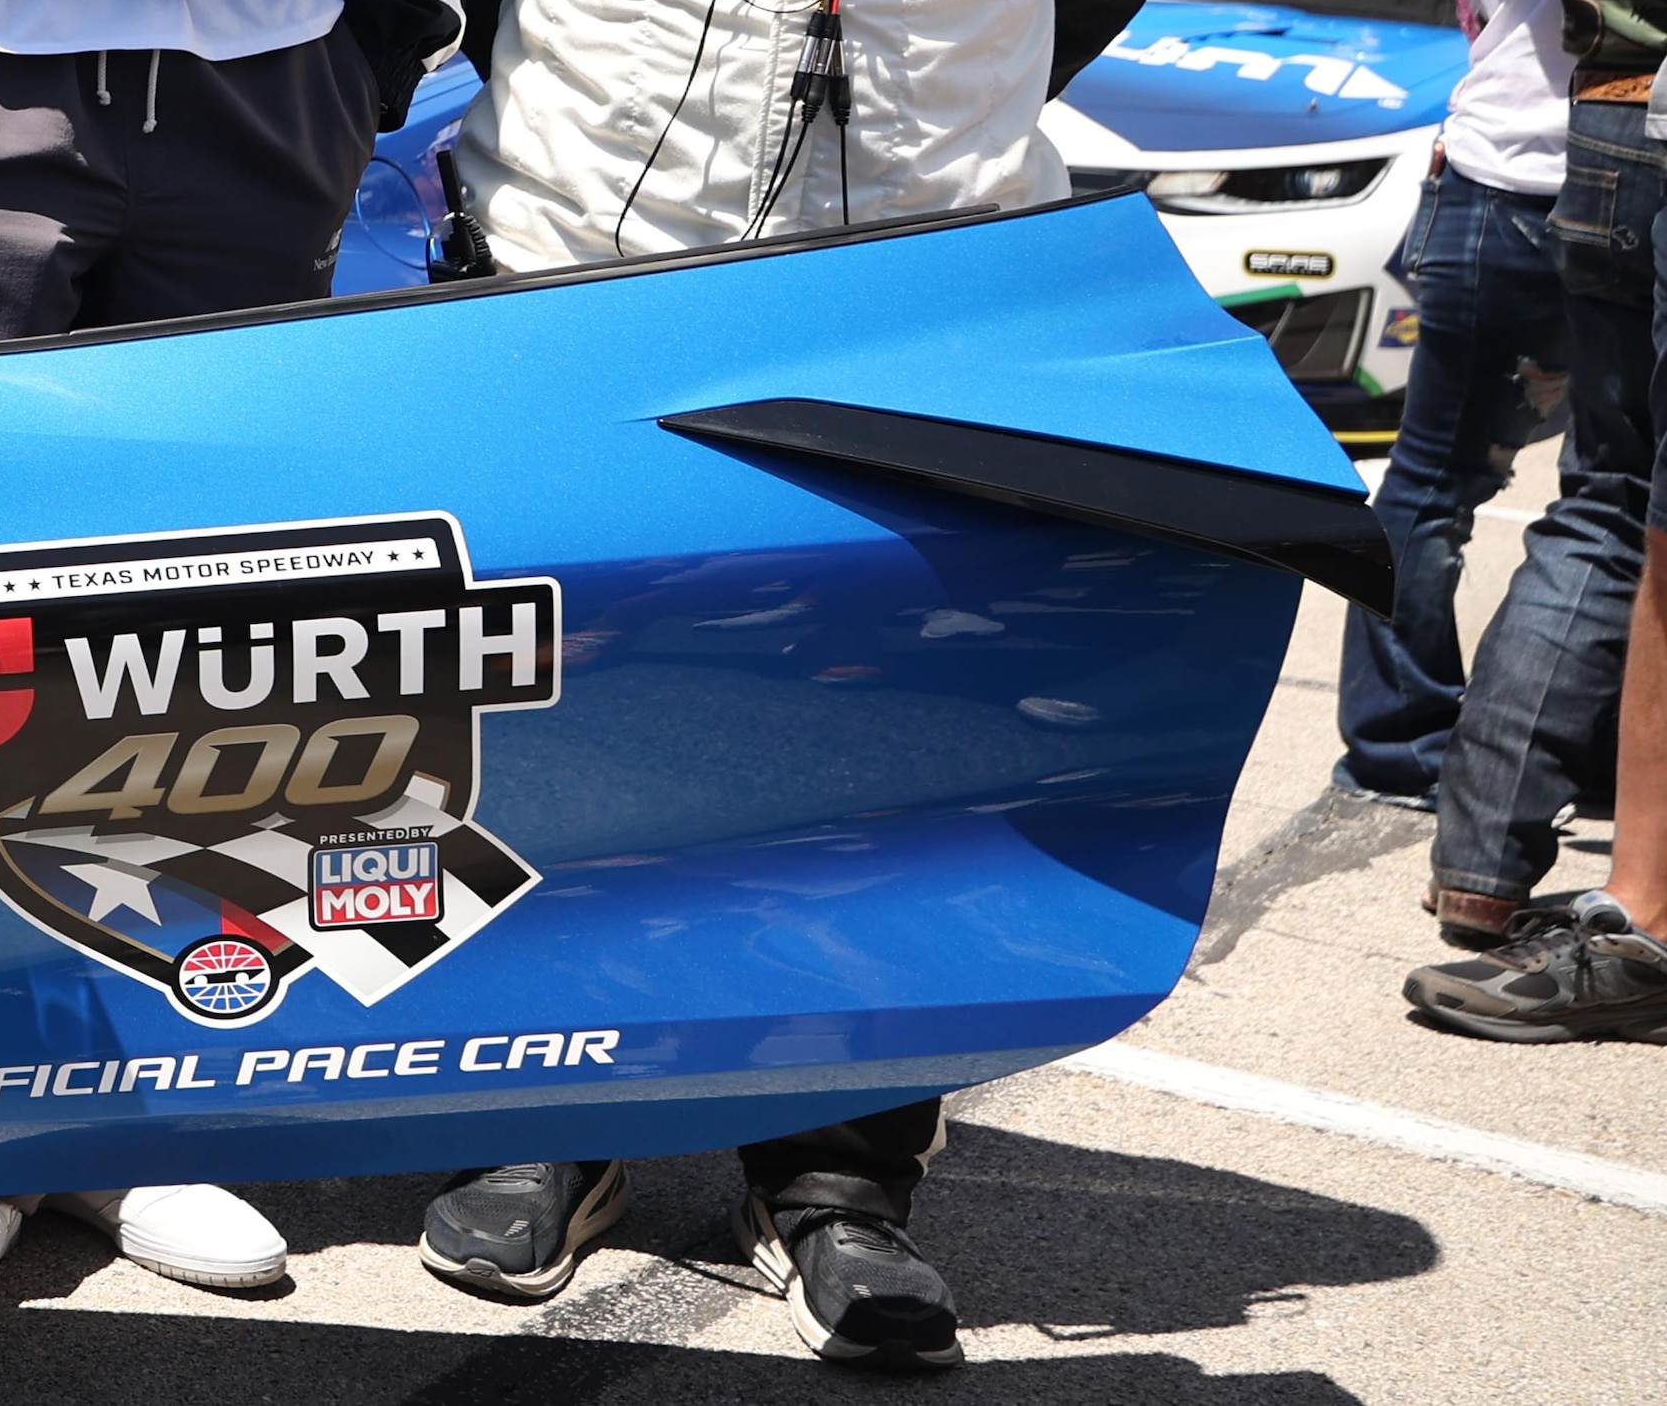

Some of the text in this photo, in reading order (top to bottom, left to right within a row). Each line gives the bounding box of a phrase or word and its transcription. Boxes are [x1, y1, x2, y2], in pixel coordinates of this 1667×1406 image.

[52, 550, 374, 590] TEXAS MOTOR SPEEDWAY
[37, 714, 420, 821] 400
[320, 827, 430, 845] PRESENTED BY
[321, 847, 430, 884] LIQUI
[321, 882, 434, 921] MOLY
[235, 1039, 446, 1086] PACE
[459, 1029, 620, 1073] CAR
